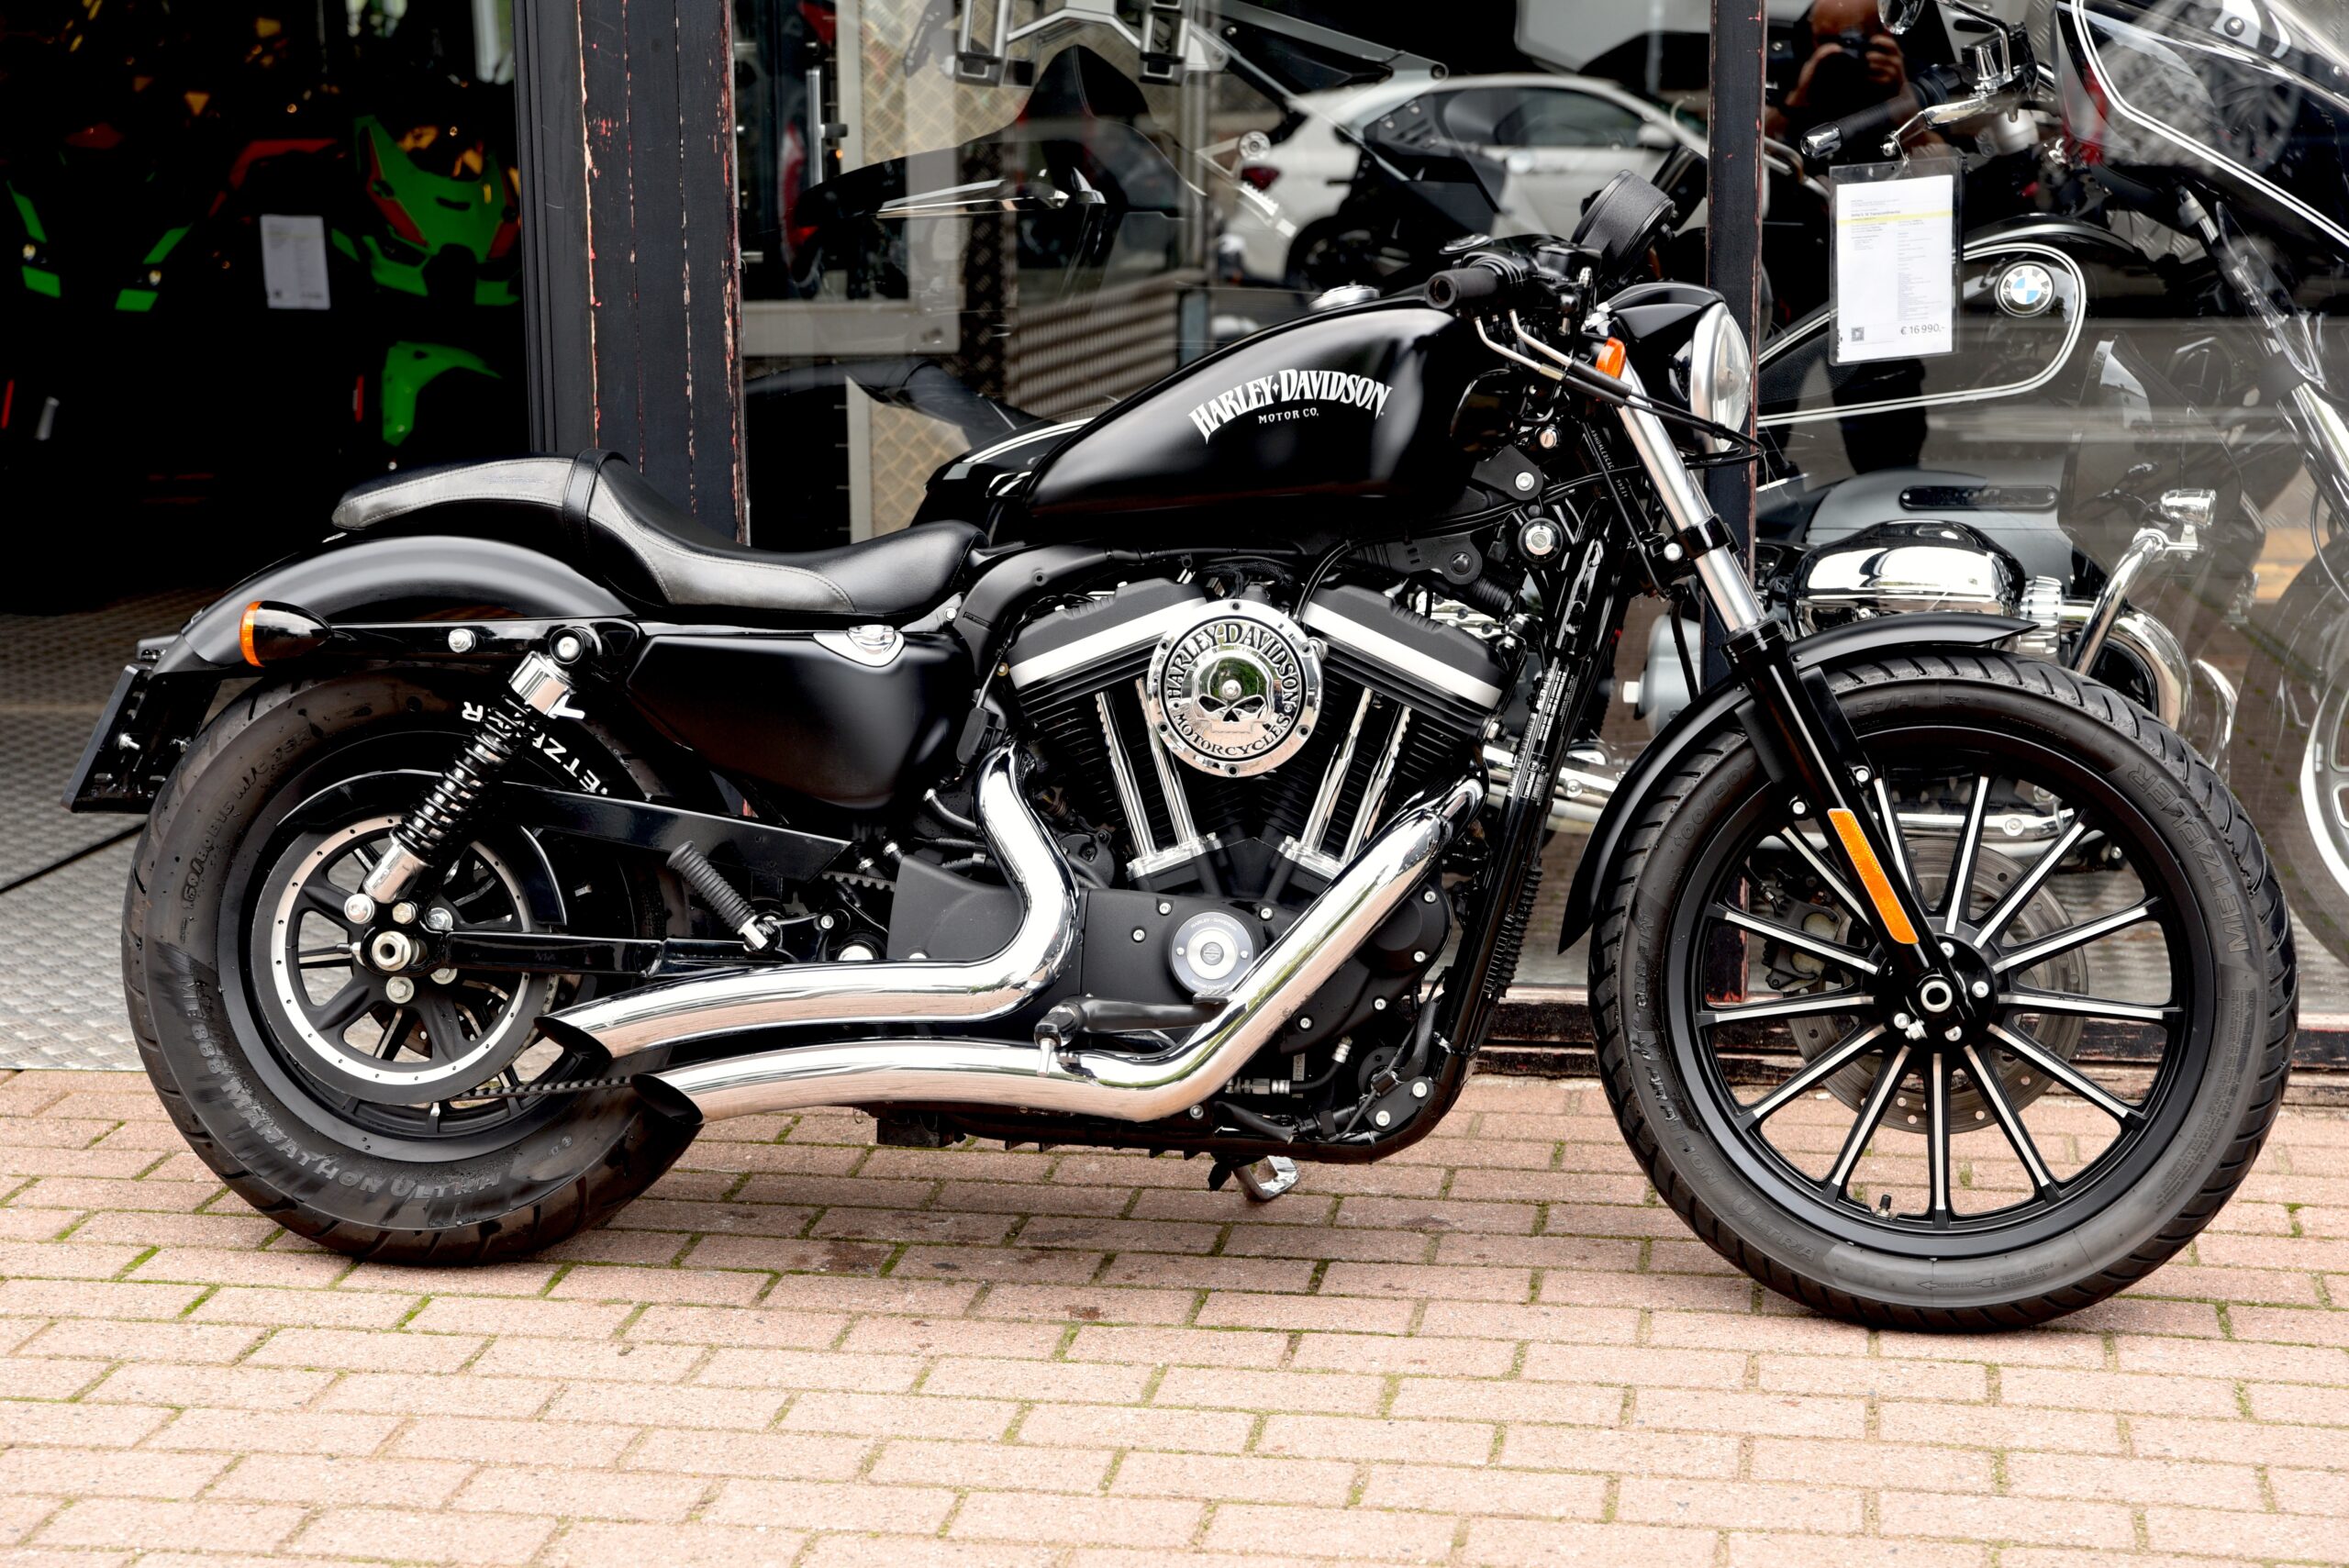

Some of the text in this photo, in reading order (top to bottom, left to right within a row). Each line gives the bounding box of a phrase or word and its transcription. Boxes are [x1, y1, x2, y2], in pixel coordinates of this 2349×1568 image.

[1900, 326, 1907, 335] €
[1258, 407, 1319, 425] MOTOR CO.
[1855, 694, 1917, 717] 57H
[1174, 713, 1292, 756] MOTORCYCLES
[2128, 763, 2250, 953] METZELER
[191, 1022, 225, 1074] 888
[219, 1075, 384, 1194] MARATHON
[390, 1173, 502, 1199] ULTRA
[1633, 1030, 1719, 1185] MARATHON
[1731, 1196, 1816, 1262] ULTRA
